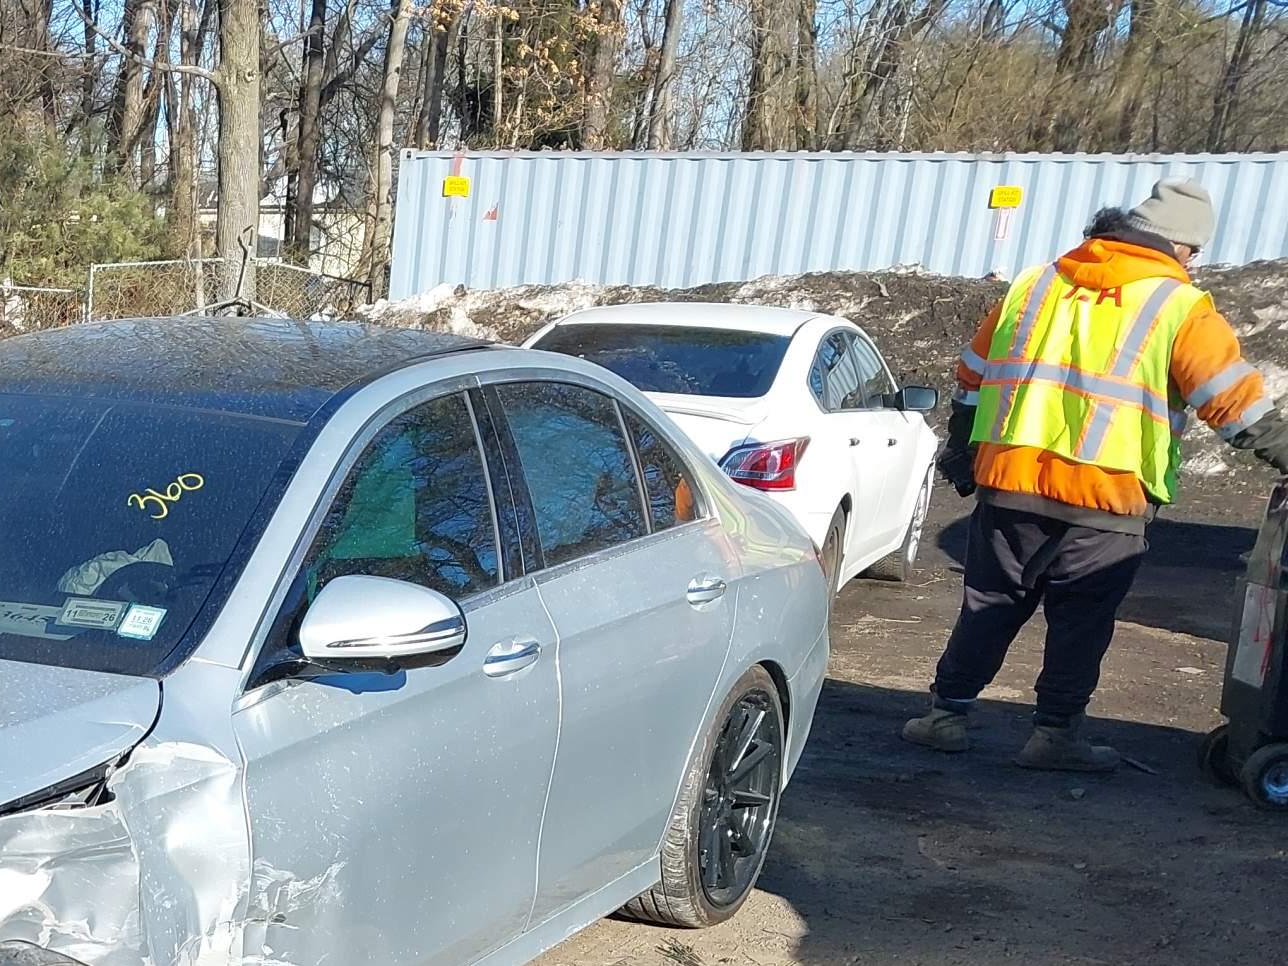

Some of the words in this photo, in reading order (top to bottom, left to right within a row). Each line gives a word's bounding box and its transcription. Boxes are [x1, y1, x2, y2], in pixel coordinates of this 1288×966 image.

[127, 473, 205, 519] 360
[66, 609, 79, 618] 11
[102, 612, 116, 622] 26
